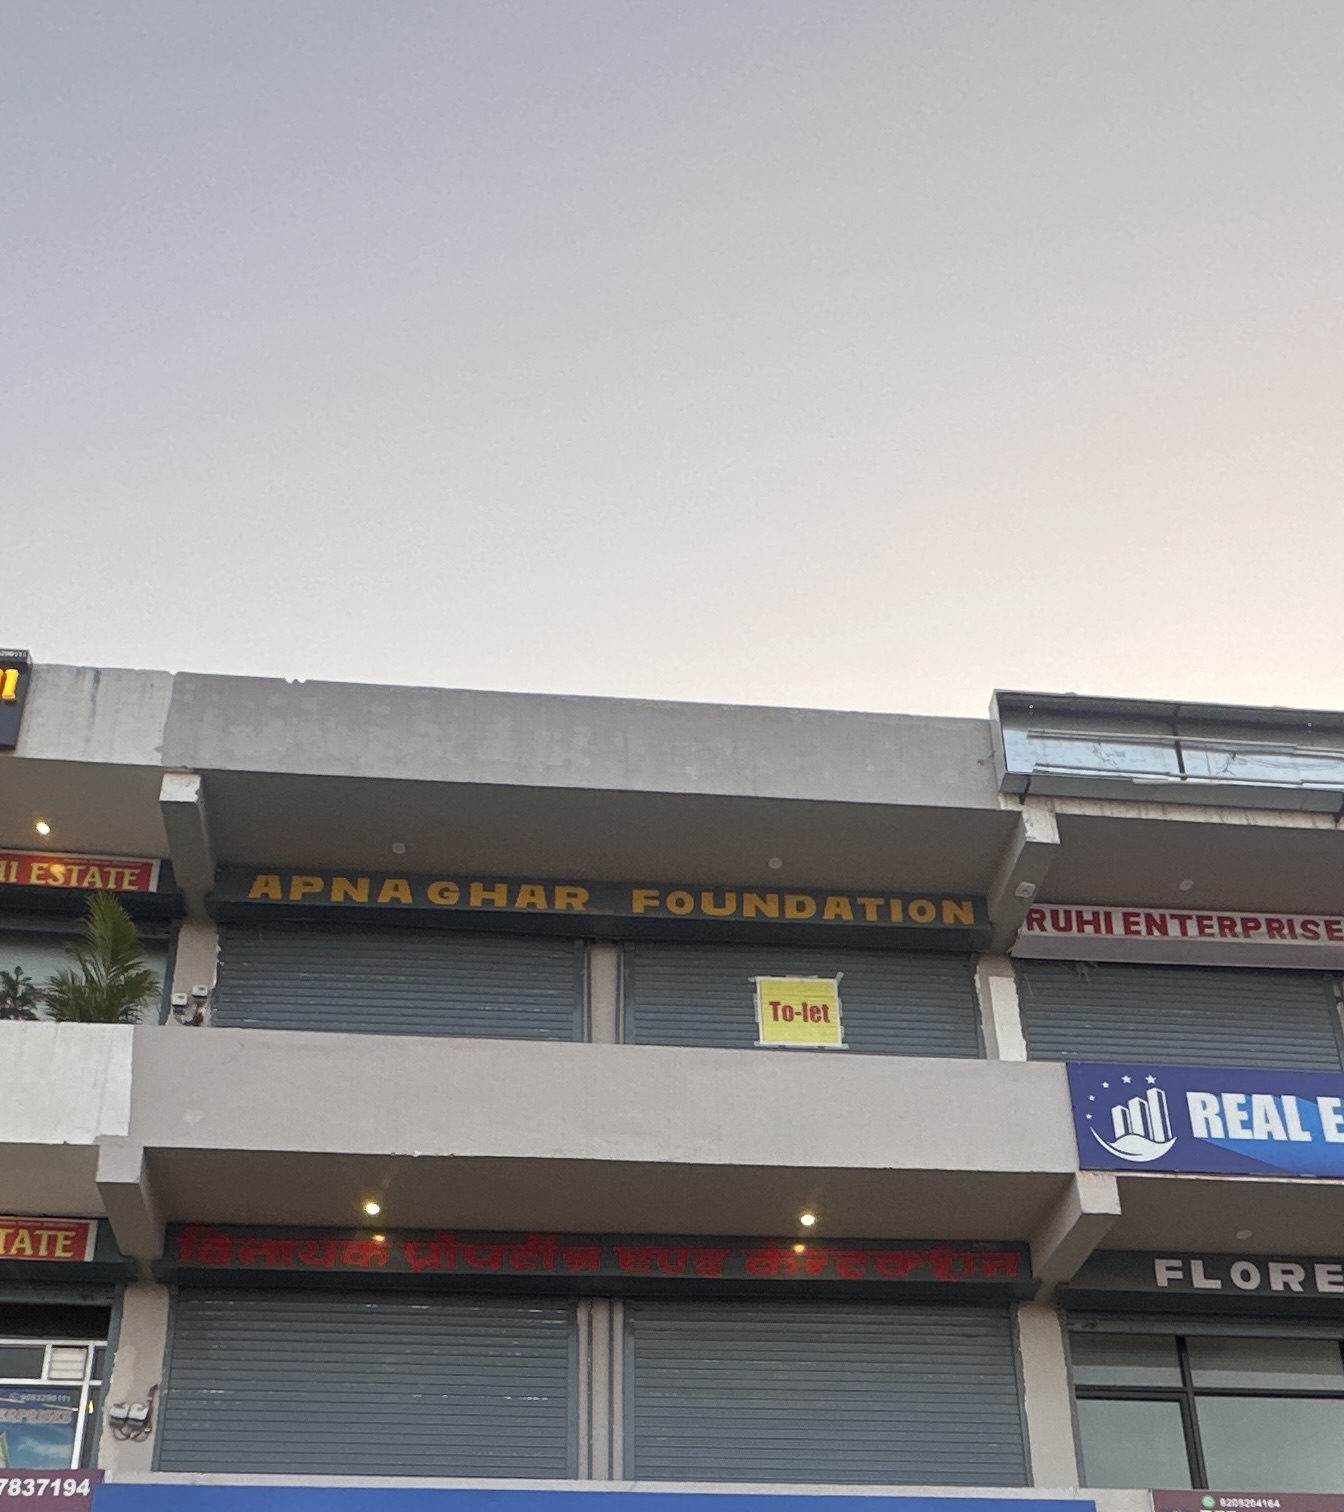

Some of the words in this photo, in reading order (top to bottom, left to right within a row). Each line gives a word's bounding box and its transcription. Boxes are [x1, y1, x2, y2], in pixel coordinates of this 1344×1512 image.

[30, 862, 142, 890] ESTATE
[248, 874, 413, 905] APNA
[427, 881, 592, 912] GHAR
[631, 889, 976, 926] FOUNDATION
[1026, 908, 1114, 934] RUHI
[769, 1000, 830, 1025] To-let
[1186, 1091, 1312, 1143] REAL
[1155, 1259, 1344, 1293] FLORE
